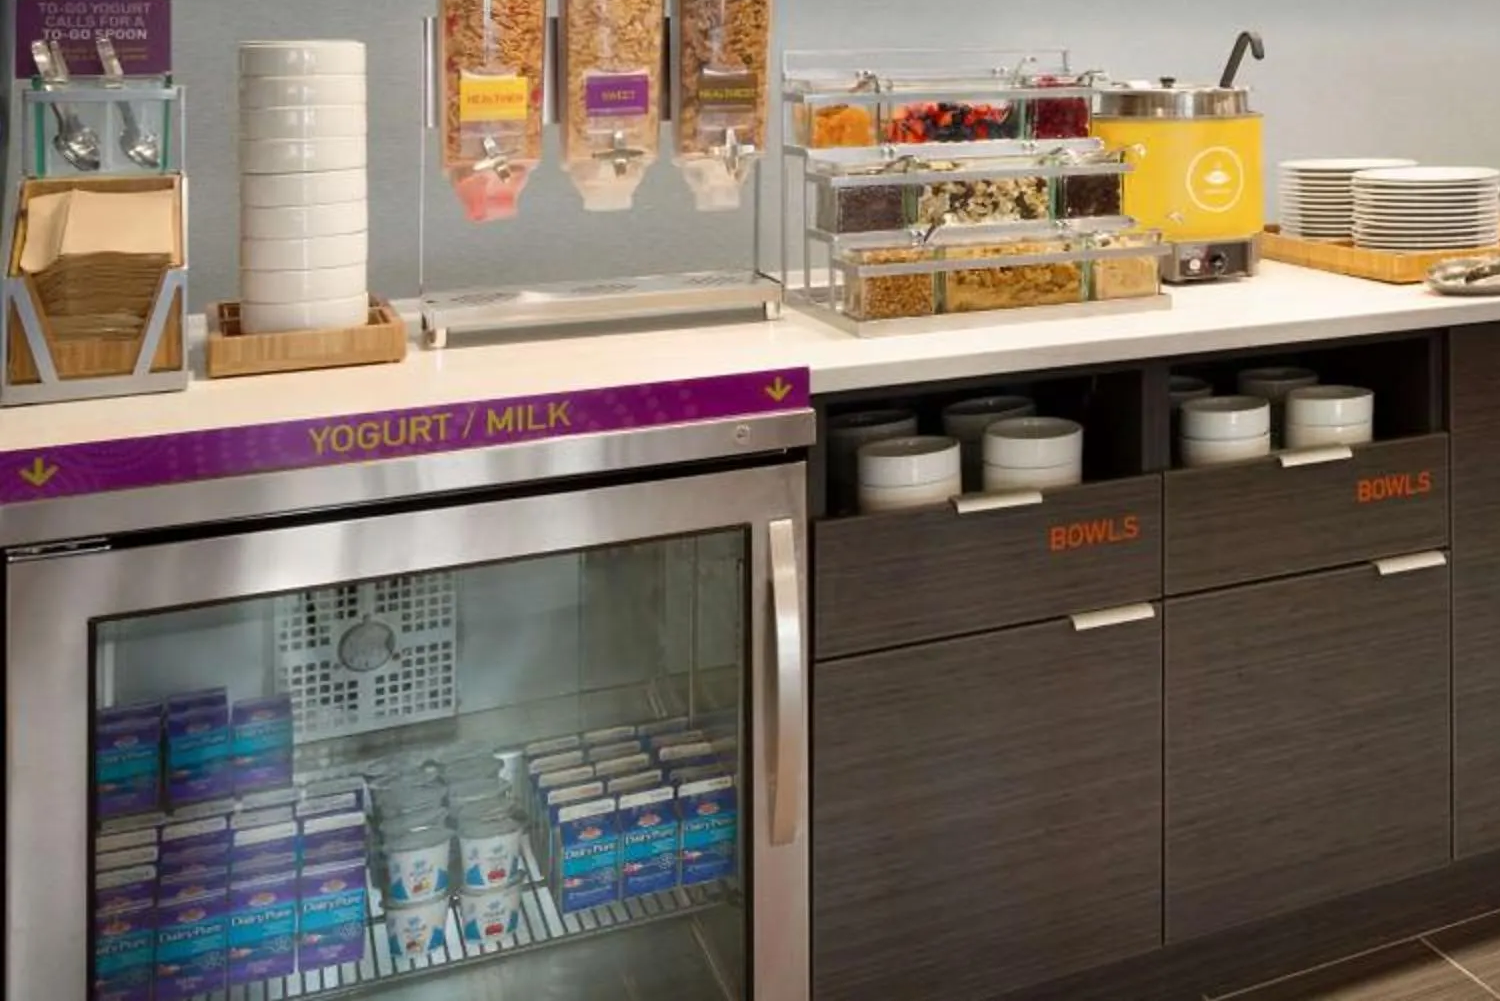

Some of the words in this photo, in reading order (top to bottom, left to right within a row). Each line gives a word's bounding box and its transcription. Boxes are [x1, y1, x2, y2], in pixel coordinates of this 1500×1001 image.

[38, 2, 88, 15] TO-GO
[90, 2, 151, 15] YOGURT
[45, 16, 95, 28] CALLS
[100, 15, 129, 27] FOR
[134, 15, 145, 27] A
[42, 29, 91, 40] TO-GO
[95, 28, 147, 40] SPOON
[308, 411, 453, 456] YOGURT
[486, 400, 573, 437] MILK
[1356, 471, 1433, 503] BOWLS
[1049, 515, 1139, 552] BOWLS
